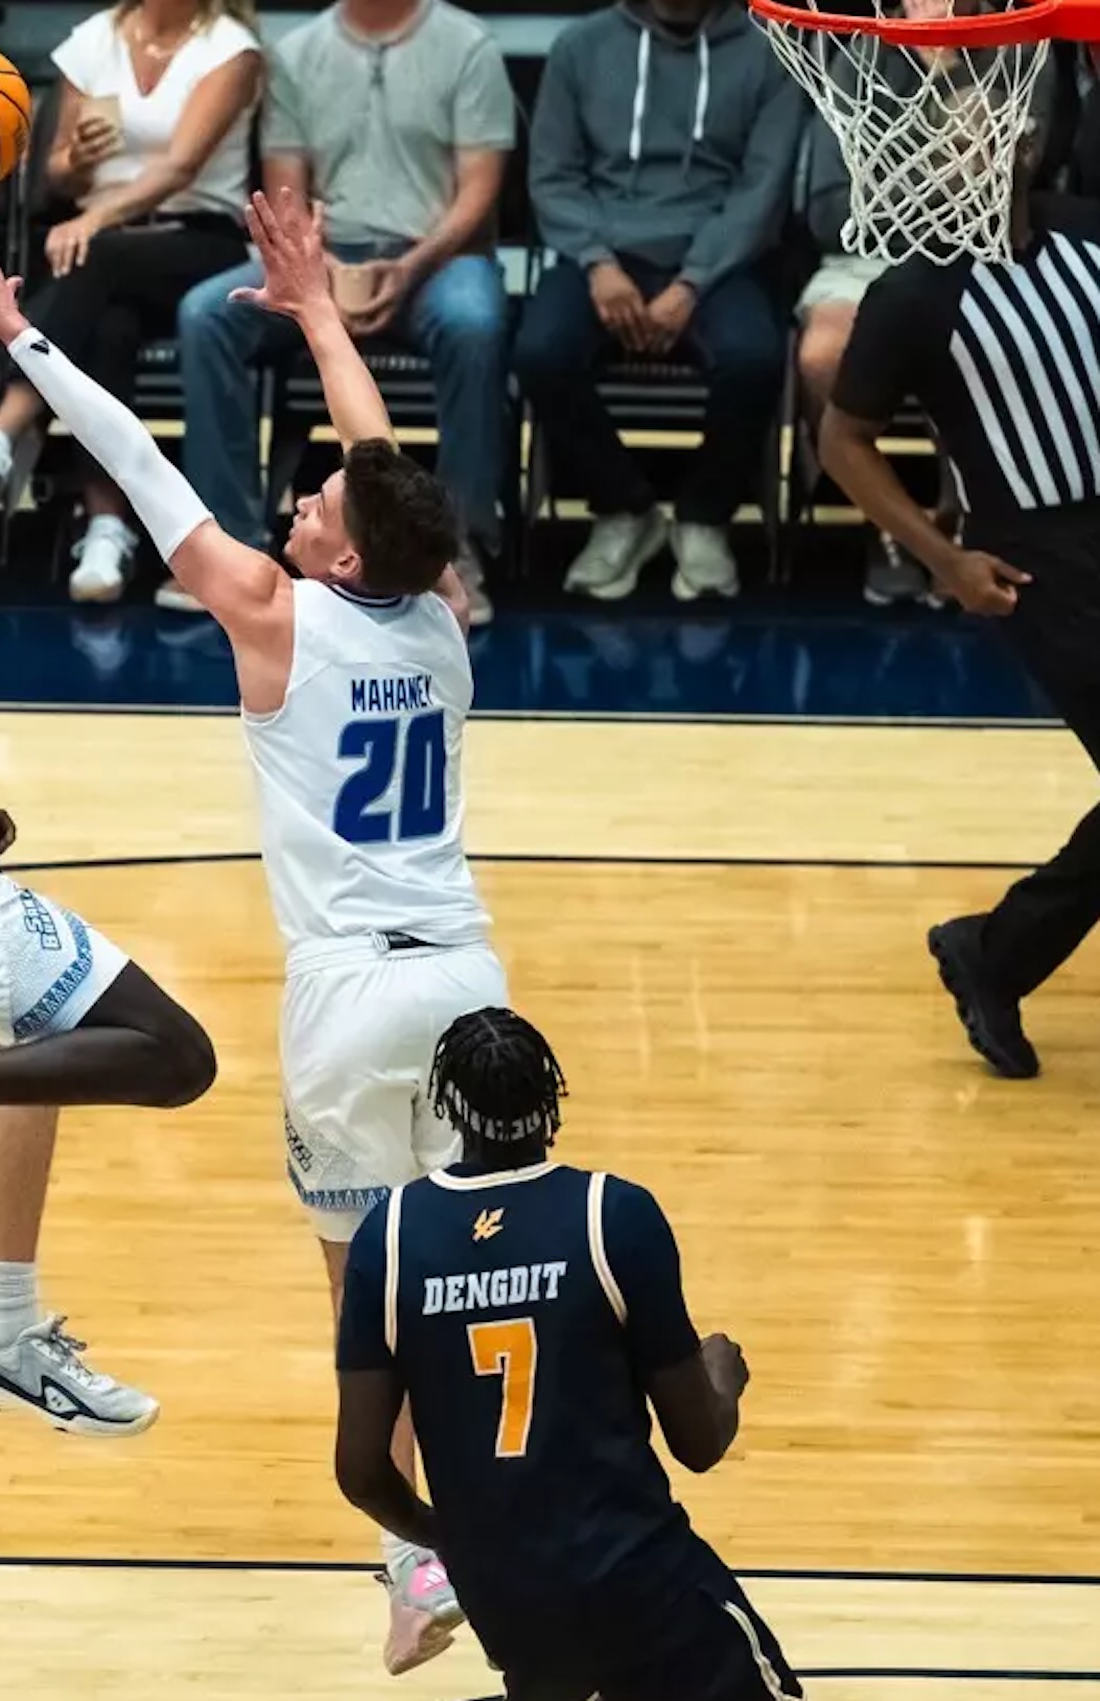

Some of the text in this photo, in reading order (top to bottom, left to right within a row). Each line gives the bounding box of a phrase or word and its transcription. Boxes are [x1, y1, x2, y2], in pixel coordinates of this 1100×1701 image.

[351, 674, 434, 713] MAHANEY
[333, 708, 447, 843] 20
[422, 1261, 568, 1316] DENGDIT
[466, 1317, 538, 1458] 7
